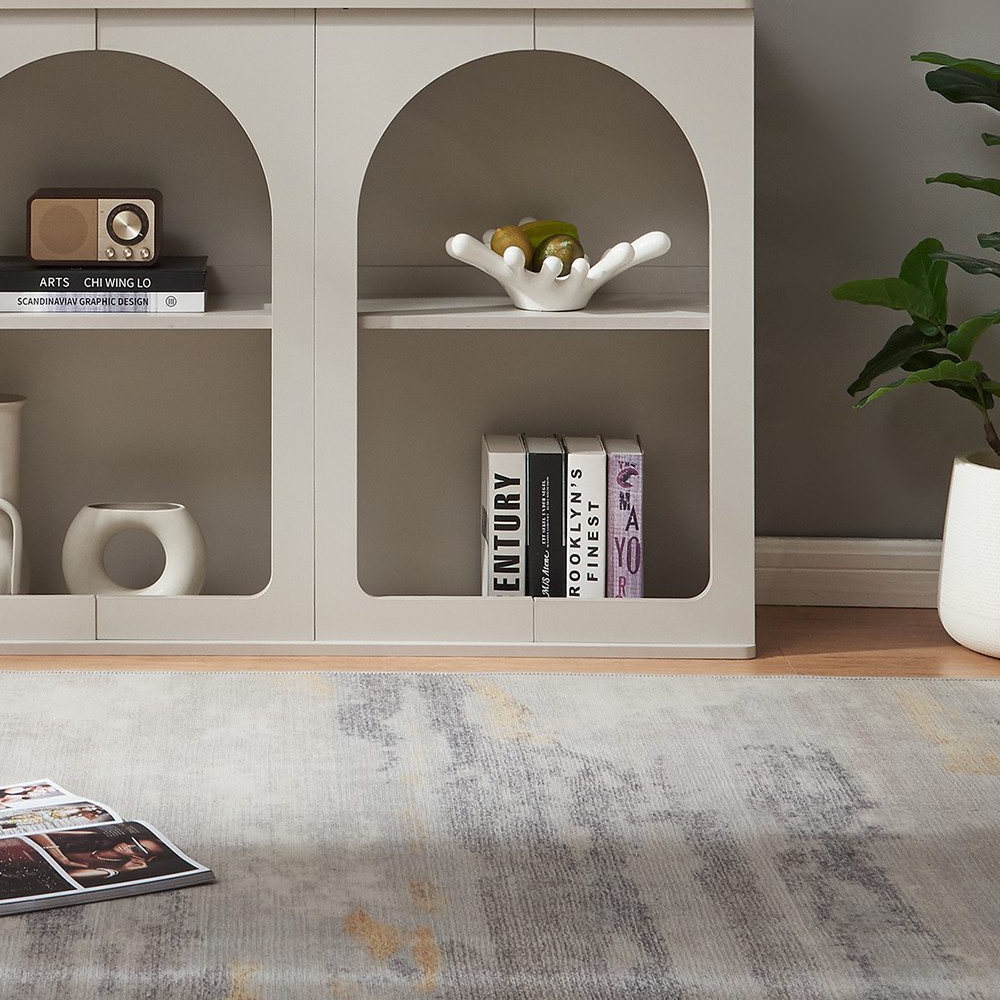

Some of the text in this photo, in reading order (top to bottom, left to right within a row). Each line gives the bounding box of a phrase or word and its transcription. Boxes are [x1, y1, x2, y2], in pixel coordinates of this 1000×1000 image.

[39, 277, 151, 288] ARTS CHI WING LO
[79, 297, 116, 306] GRAPHIC
[117, 297, 149, 306] DESIGN
[493, 473, 521, 597] ENTURY
[587, 501, 600, 582] FINEST
